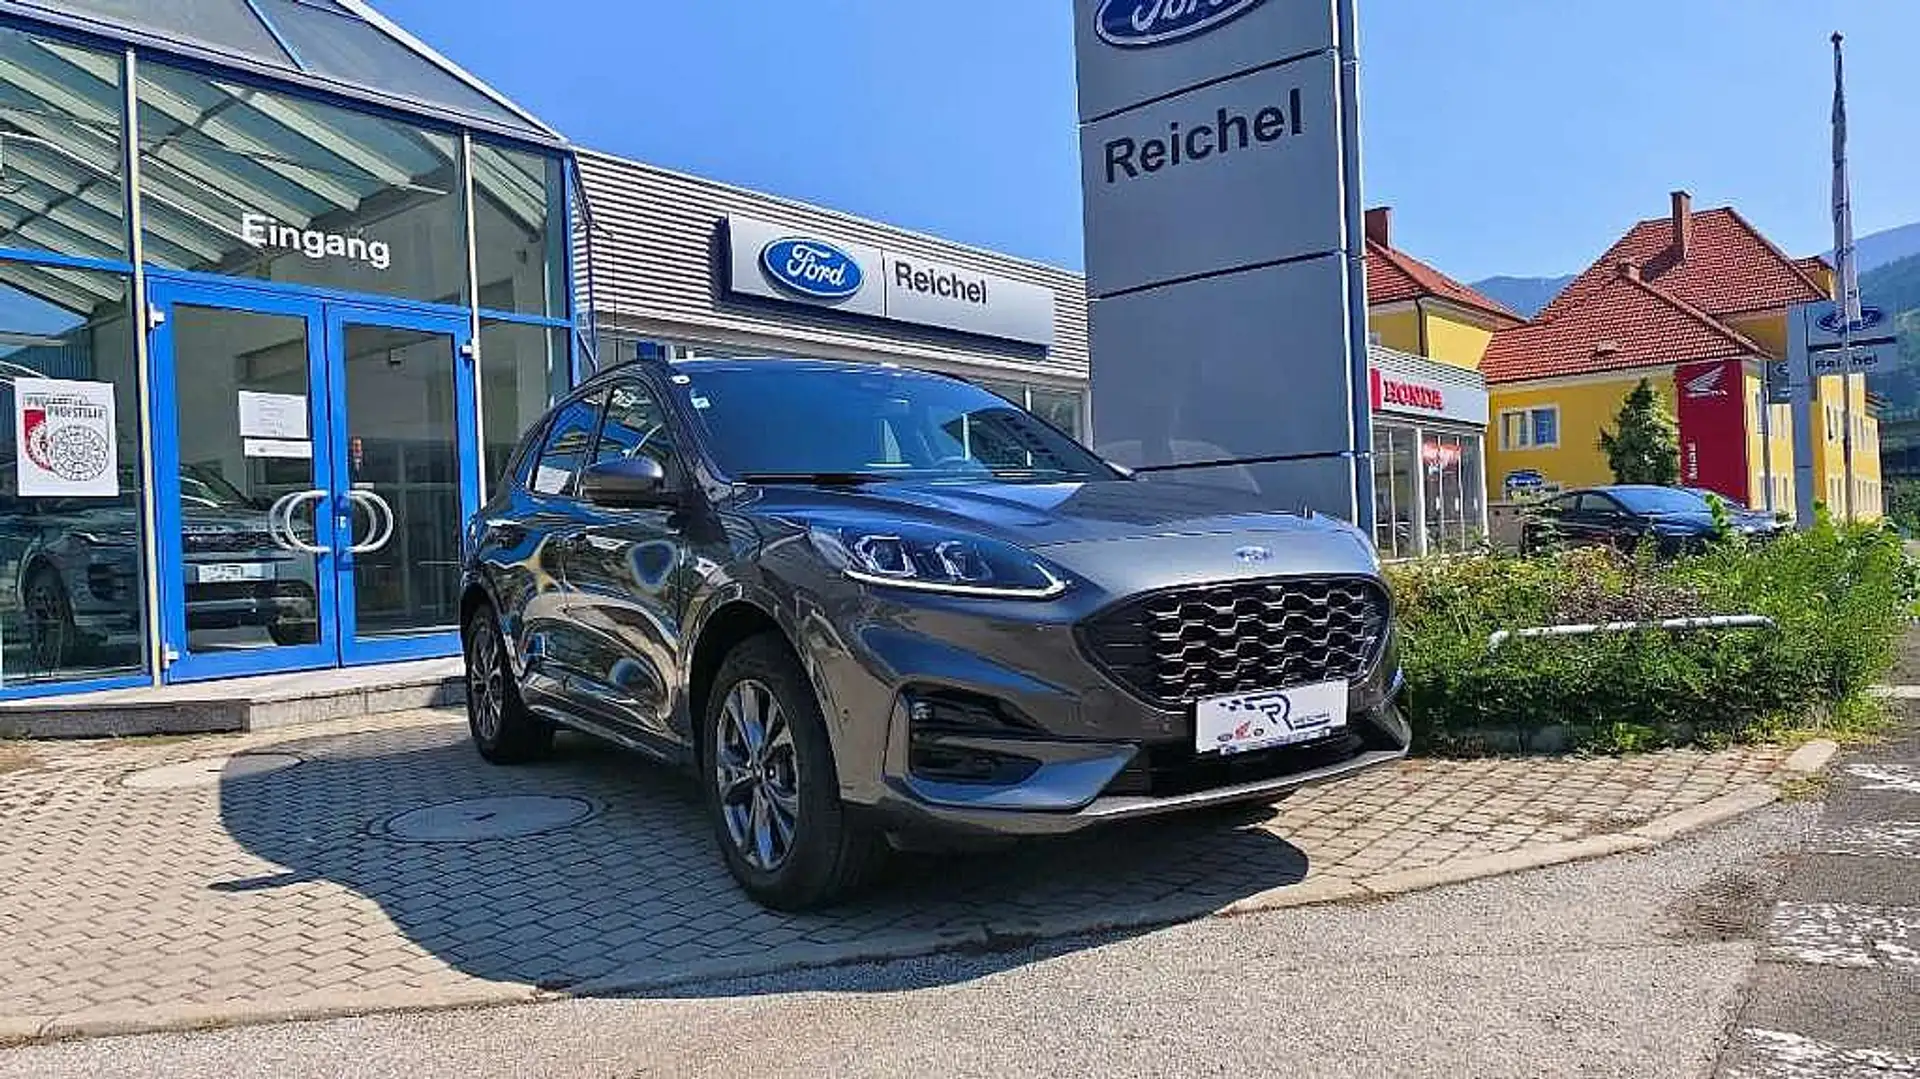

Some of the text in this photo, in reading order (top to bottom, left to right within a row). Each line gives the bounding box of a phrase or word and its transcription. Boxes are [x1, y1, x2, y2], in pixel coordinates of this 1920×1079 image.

[1104, 88, 1303, 183] Reichel
[241, 211, 390, 269] Eingang
[786, 244, 846, 286] Ford
[895, 260, 987, 304] Reichel
[1815, 351, 1878, 369] Reihel
[1382, 379, 1443, 410] HONDA
